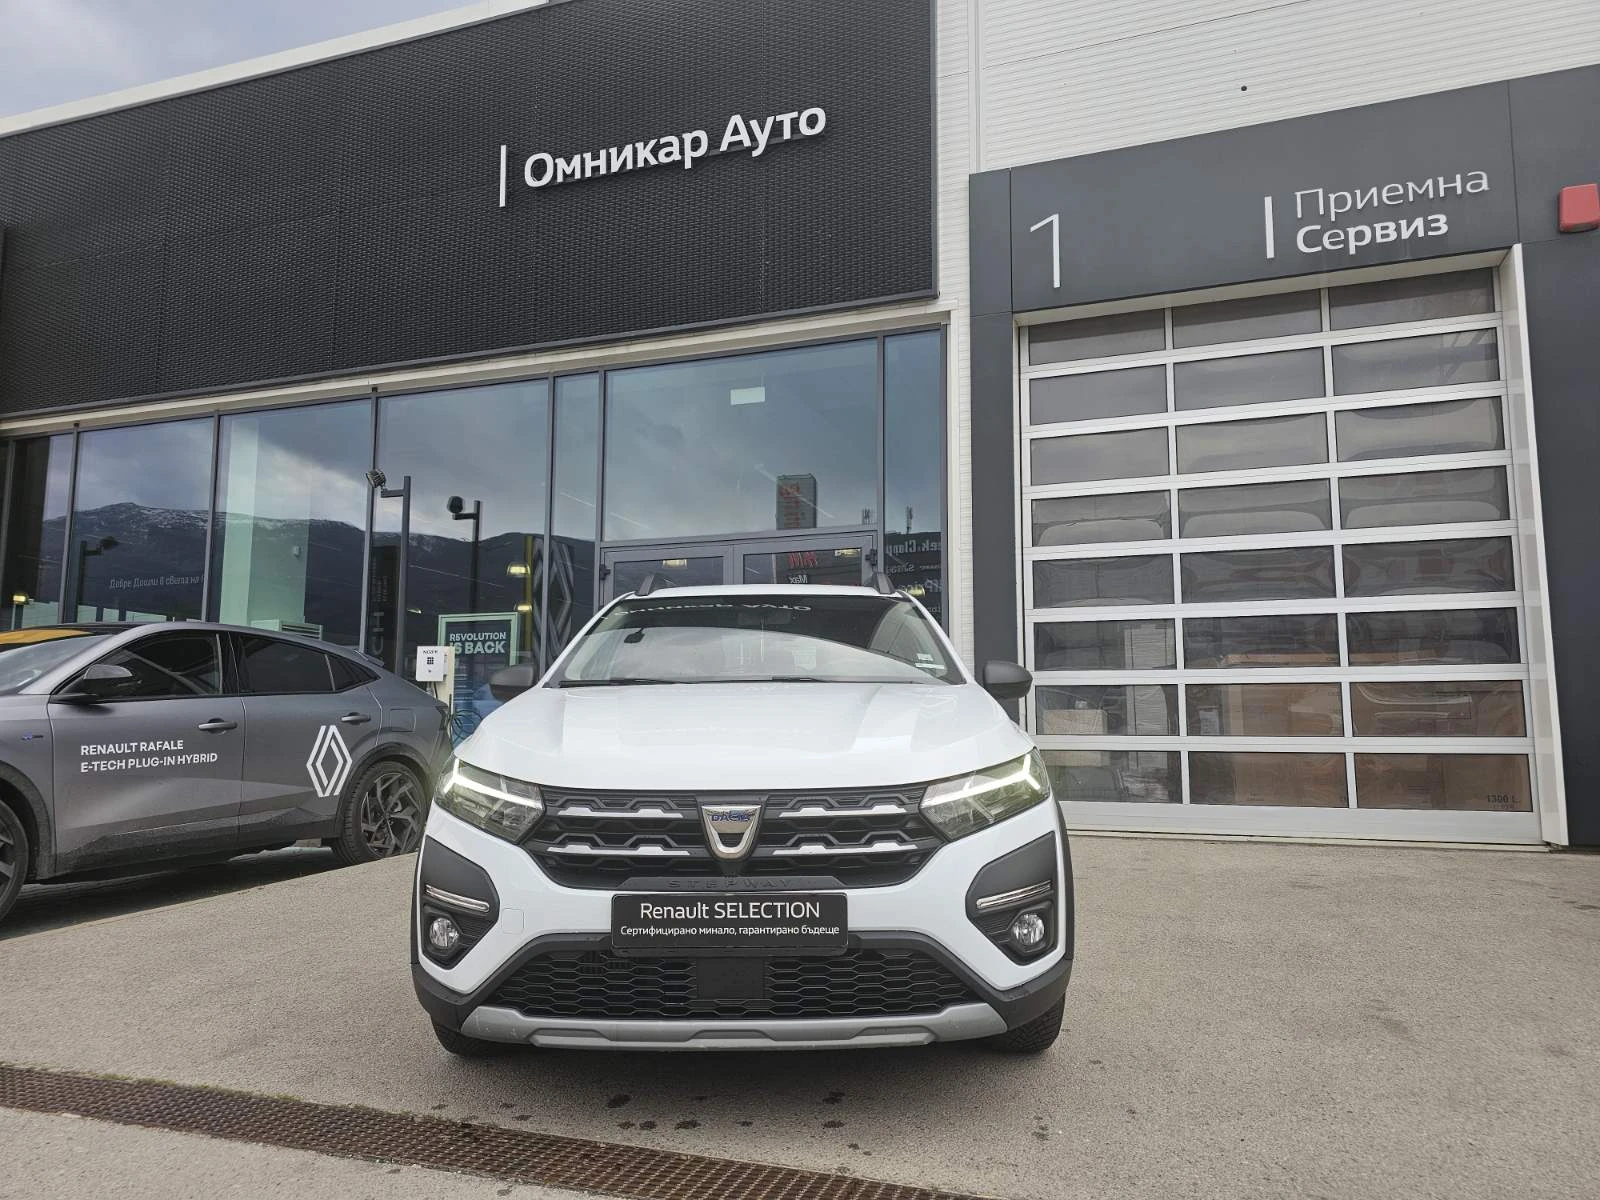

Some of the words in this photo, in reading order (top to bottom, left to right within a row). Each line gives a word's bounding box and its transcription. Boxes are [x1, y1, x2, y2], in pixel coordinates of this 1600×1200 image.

[523, 128, 709, 188] Омникар
[719, 106, 827, 158] Ауто
[1293, 169, 1490, 222] Приемна
[1296, 210, 1450, 256] Сервиз
[1029, 212, 1062, 289] 1
[449, 631, 507, 642] REVOLUTION
[464, 640, 506, 655] BACK
[80, 742, 138, 757] RENAULT
[139, 739, 184, 753] RAFALE
[80, 758, 126, 773] E-TECH
[127, 755, 175, 771] PLUG-IN
[176, 752, 218, 766] HYBRID
[668, 879, 792, 889] STEPWAY
[640, 901, 710, 919] Renault
[714, 901, 820, 919] SELECTION
[620, 925, 698, 937] Сертифицирано
[698, 927, 737, 937] минало,
[738, 926, 800, 936] гарантирано
[801, 925, 840, 937] бъдеще
